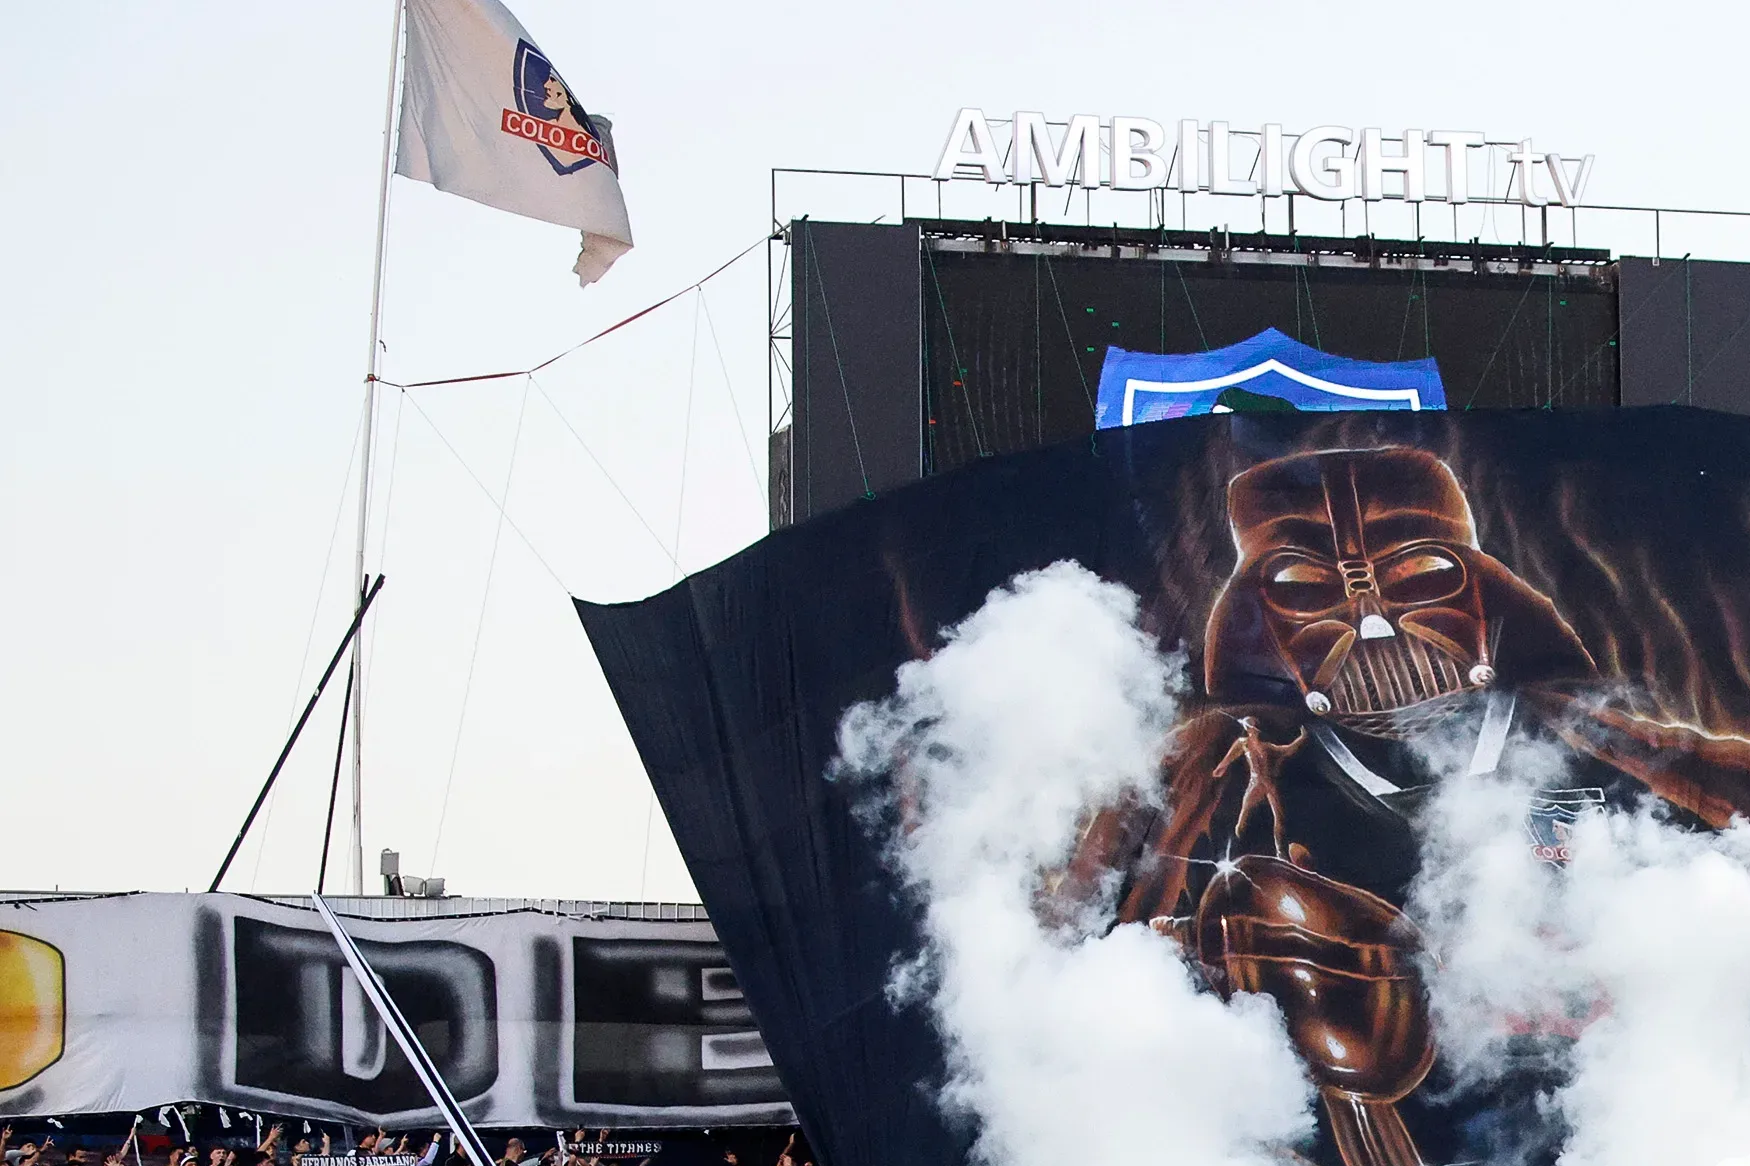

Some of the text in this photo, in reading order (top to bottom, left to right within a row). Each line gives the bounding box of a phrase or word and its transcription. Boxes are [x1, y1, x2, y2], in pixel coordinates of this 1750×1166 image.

[506, 113, 610, 164] COLO COL
[934, 108, 1595, 208] AMBILIGHT tv
